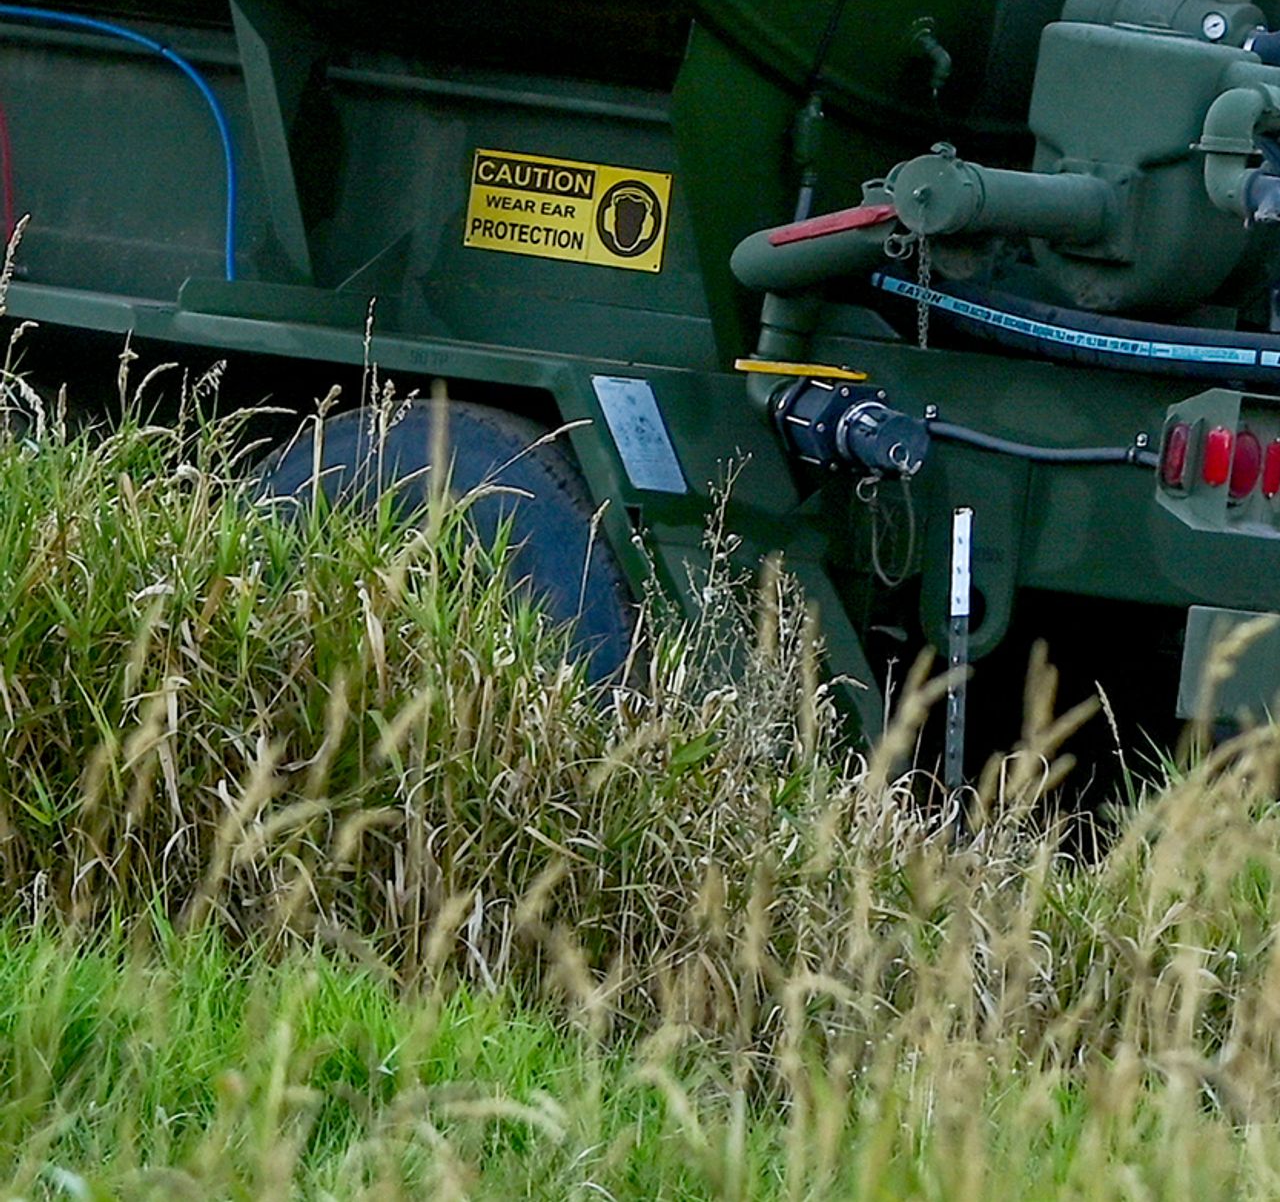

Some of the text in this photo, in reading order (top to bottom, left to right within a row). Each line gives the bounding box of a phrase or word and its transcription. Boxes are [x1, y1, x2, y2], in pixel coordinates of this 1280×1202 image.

[478, 160, 592, 194] CAUTION
[486, 194, 575, 219] WEAR EAR
[471, 218, 584, 250] PROTECTION
